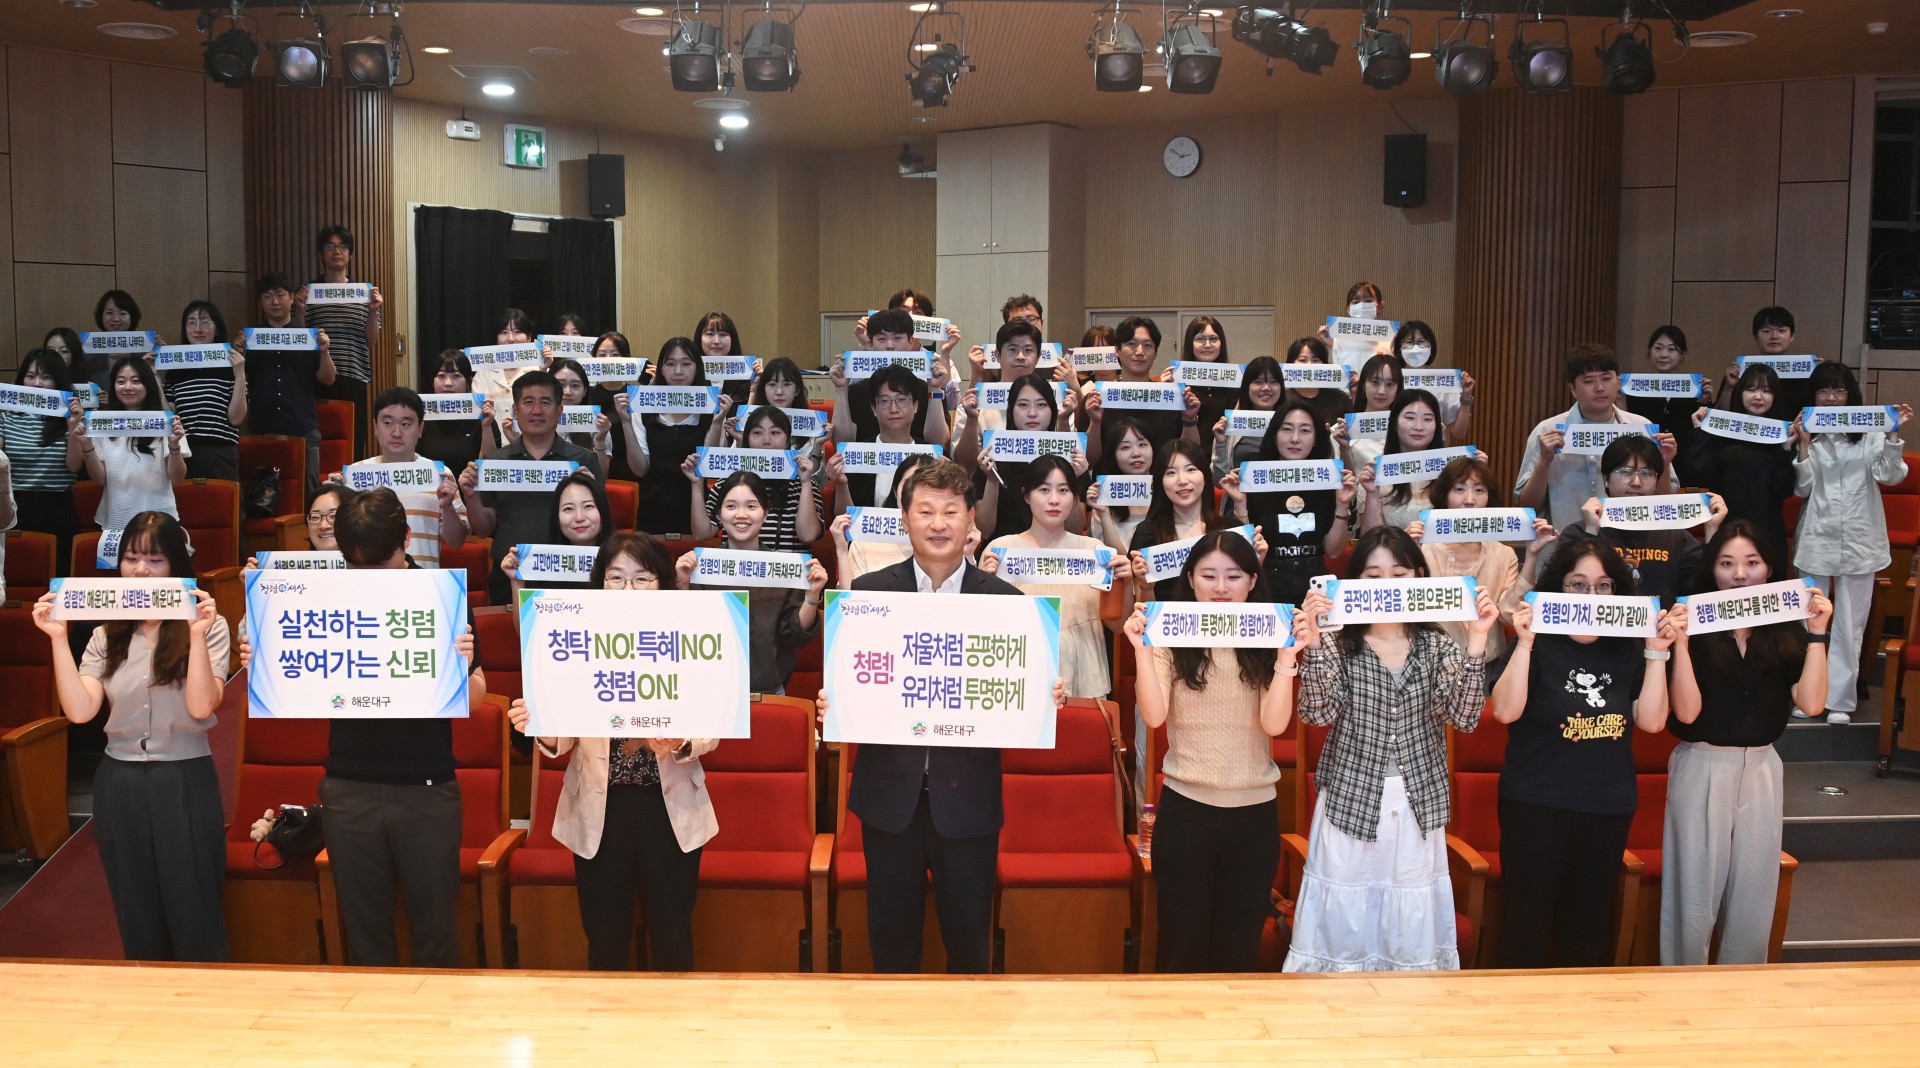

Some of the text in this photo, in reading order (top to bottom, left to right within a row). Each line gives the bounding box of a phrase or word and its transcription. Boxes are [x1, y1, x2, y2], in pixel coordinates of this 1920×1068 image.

[1572, 430, 1591, 447] 청렴은
[709, 454, 726, 471] 중요한
[727, 454, 739, 471] 것은
[771, 456, 785, 473] 청렴!
[352, 468, 433, 489] 청렴의 가치, 우리가 같이!
[484, 469, 543, 484] 갑질행위 근절! 직원간
[1252, 466, 1330, 485] 청렴! 해운대구를 위한 약속
[1109, 481, 1149, 500] 청렴의 가치,
[862, 514, 881, 534] 중요한
[883, 515, 897, 536] 것은
[1435, 515, 1521, 535] 청렴! 해운대구를 위한 약속
[532, 553, 577, 574] 고민하면 부패,
[700, 557, 802, 580] 청렴의 바람, 해운대를 가득채우다
[1006, 556, 1096, 577] 공정하게! 투명하게! 청렴하게!
[64, 588, 182, 609] 청렴한 해운대구, 신뢰받는 해운대구
[1373, 588, 1405, 614] 첫걸음,
[1406, 587, 1463, 612] 청렴으로부터
[1696, 590, 1801, 624] 청렴! 해운대구를 위한 약속
[278, 609, 436, 639] 실천하는 청렴
[1162, 613, 1276, 637] 공정하게! 투명하게! 청렴하게!
[1541, 601, 1649, 628] 청렴의 가치, 우리가 같이!
[548, 629, 592, 662] 청탁
[902, 631, 1027, 668] 저울처럼 공평하게
[278, 649, 436, 679] 쌓여가는 신뢰
[853, 650, 894, 685] 청렴!
[351, 696, 391, 708] 해운대구
[901, 675, 1025, 711] 유리처럼 투명하게
[630, 716, 671, 728] 해운대구
[933, 724, 975, 737] 해운대구
[1567, 713, 1624, 729] TAKE CARE
[1562, 725, 1625, 740] OF YOURSELF
